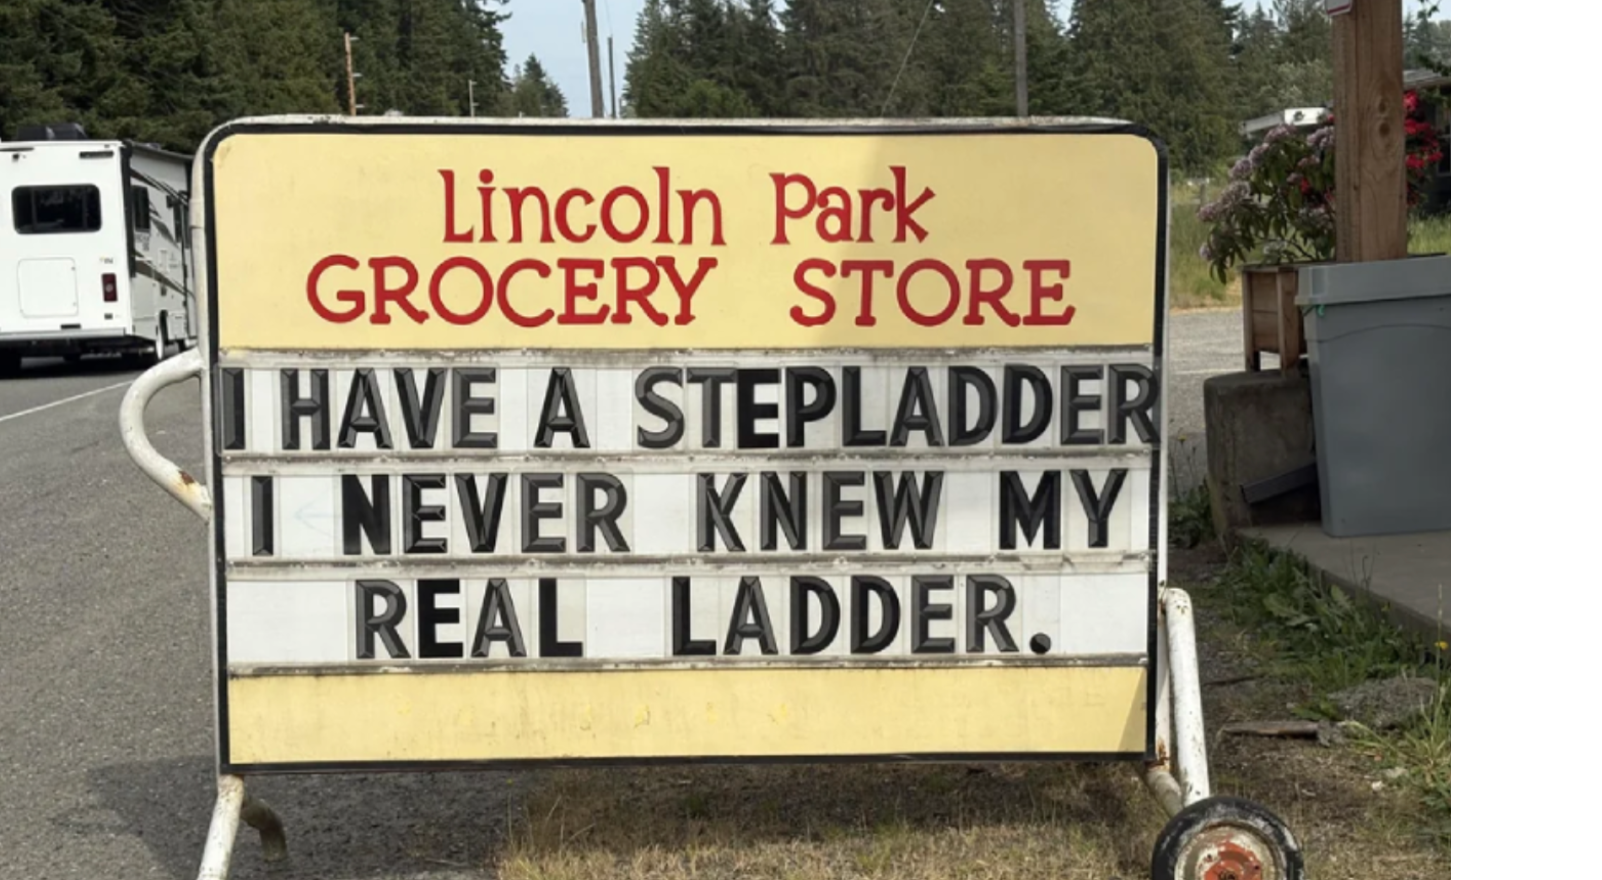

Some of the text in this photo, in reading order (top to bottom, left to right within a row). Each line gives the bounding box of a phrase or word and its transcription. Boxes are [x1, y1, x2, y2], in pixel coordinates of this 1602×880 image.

[440, 166, 935, 246] Lincoln Park
[306, 254, 1076, 328] GROCERY STORE
[222, 364, 1160, 450] I HAVE A STEPLADDER
[252, 468, 1128, 555] I NEVER KNEW MY
[355, 574, 1052, 659] REAL LADDER.
